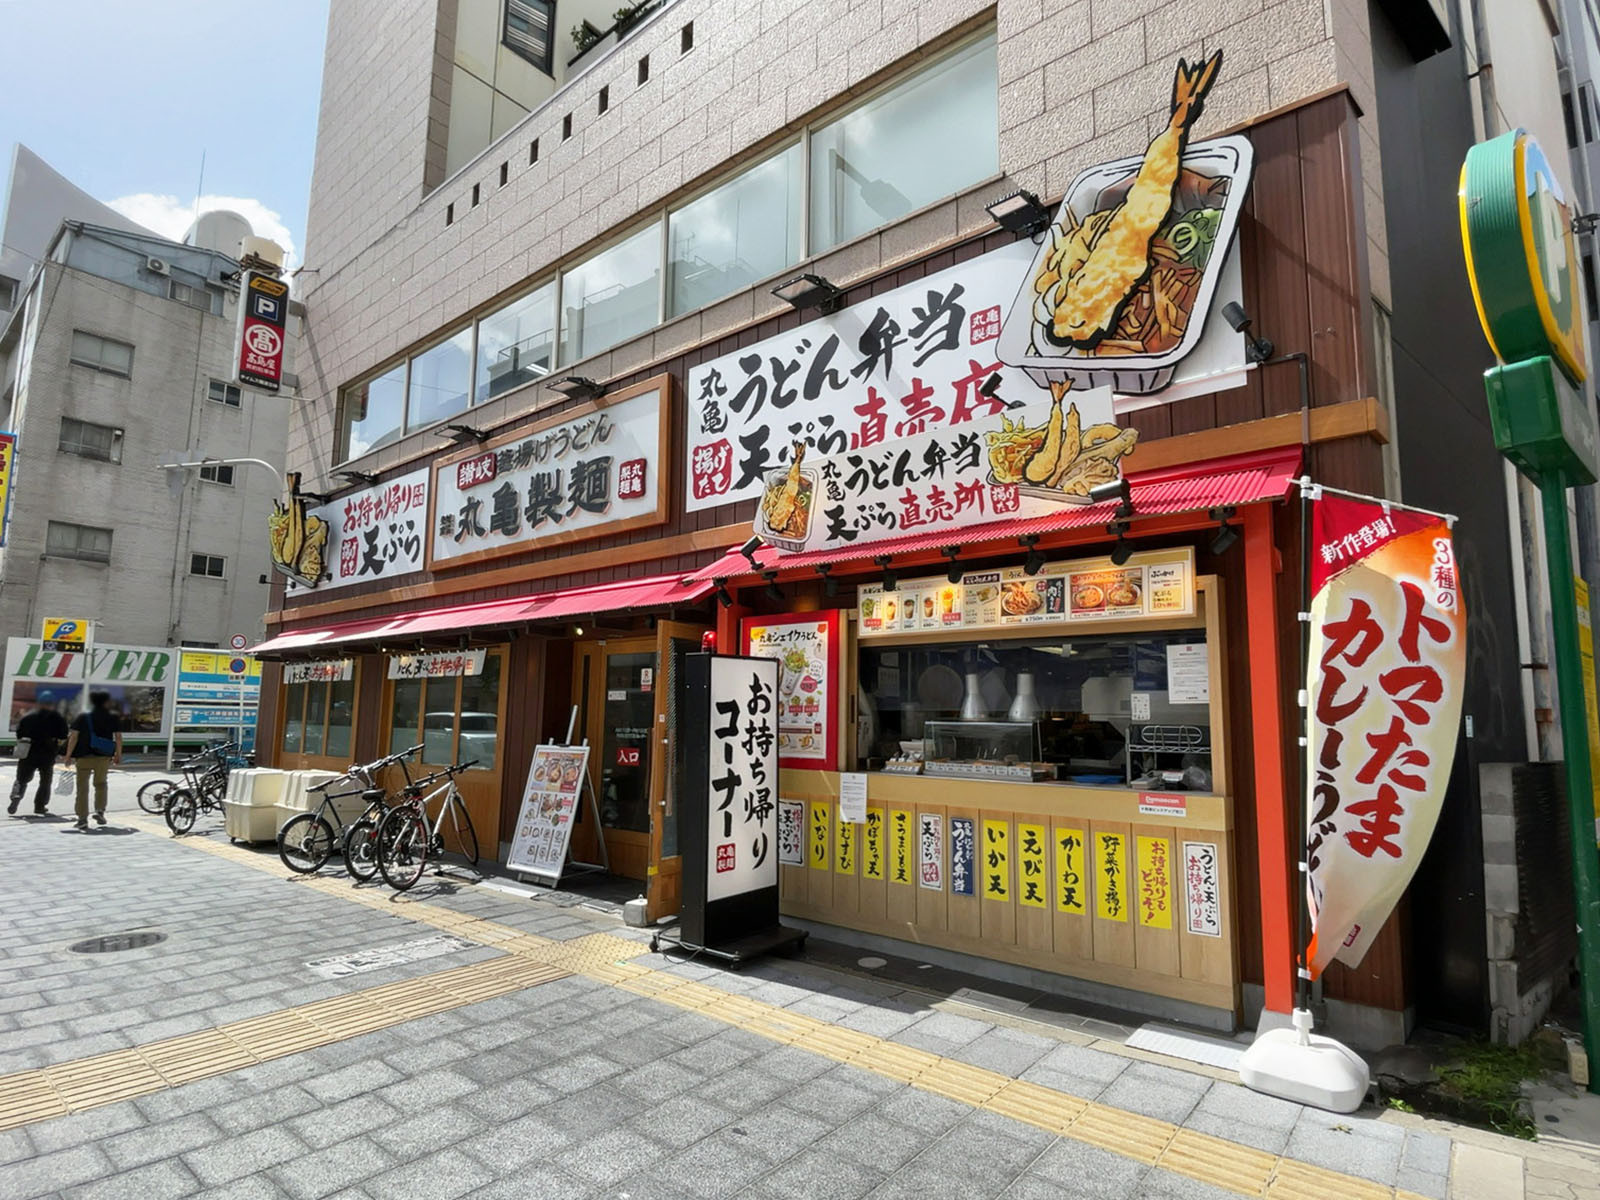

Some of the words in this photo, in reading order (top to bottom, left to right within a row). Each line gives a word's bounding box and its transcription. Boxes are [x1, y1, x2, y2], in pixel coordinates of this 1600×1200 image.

[258, 298, 275, 314] P
[729, 283, 965, 424] うどん弁当
[698, 367, 728, 434] 丸亀
[458, 456, 494, 487] 讃岐
[821, 460, 847, 502] 丸亀
[845, 432, 981, 498] うどん弁当
[343, 484, 412, 533] お持ち帰り
[454, 456, 614, 543] 丸亀製麺
[824, 478, 986, 542] 天ぷら直売所
[357, 519, 421, 577] 天ぷら
[1320, 515, 1397, 564] 新作登場!
[1435, 540, 1455, 607] 3種の
[1306, 597, 1384, 902] カレーうど
[1344, 581, 1451, 859] トマたま
[618, 749, 639, 763] 入口
[712, 699, 742, 838] コーナー
[741, 672, 775, 870] お持ち帰り
[782, 808, 793, 854] 天ぷら
[814, 808, 827, 861] いなり
[866, 812, 881, 876] かぼちゃ天
[922, 821, 935, 860] 天ぷら
[952, 821, 968, 892] うどん弁当
[987, 827, 1006, 895] いか天
[1022, 830, 1043, 903] えび天
[1060, 835, 1082, 908] かしわ天
[1102, 836, 1121, 917] 野菜かき揚げ
[1151, 841, 1168, 911] お持ち帰りも
[1188, 855, 1204, 918] お持ち帰り
